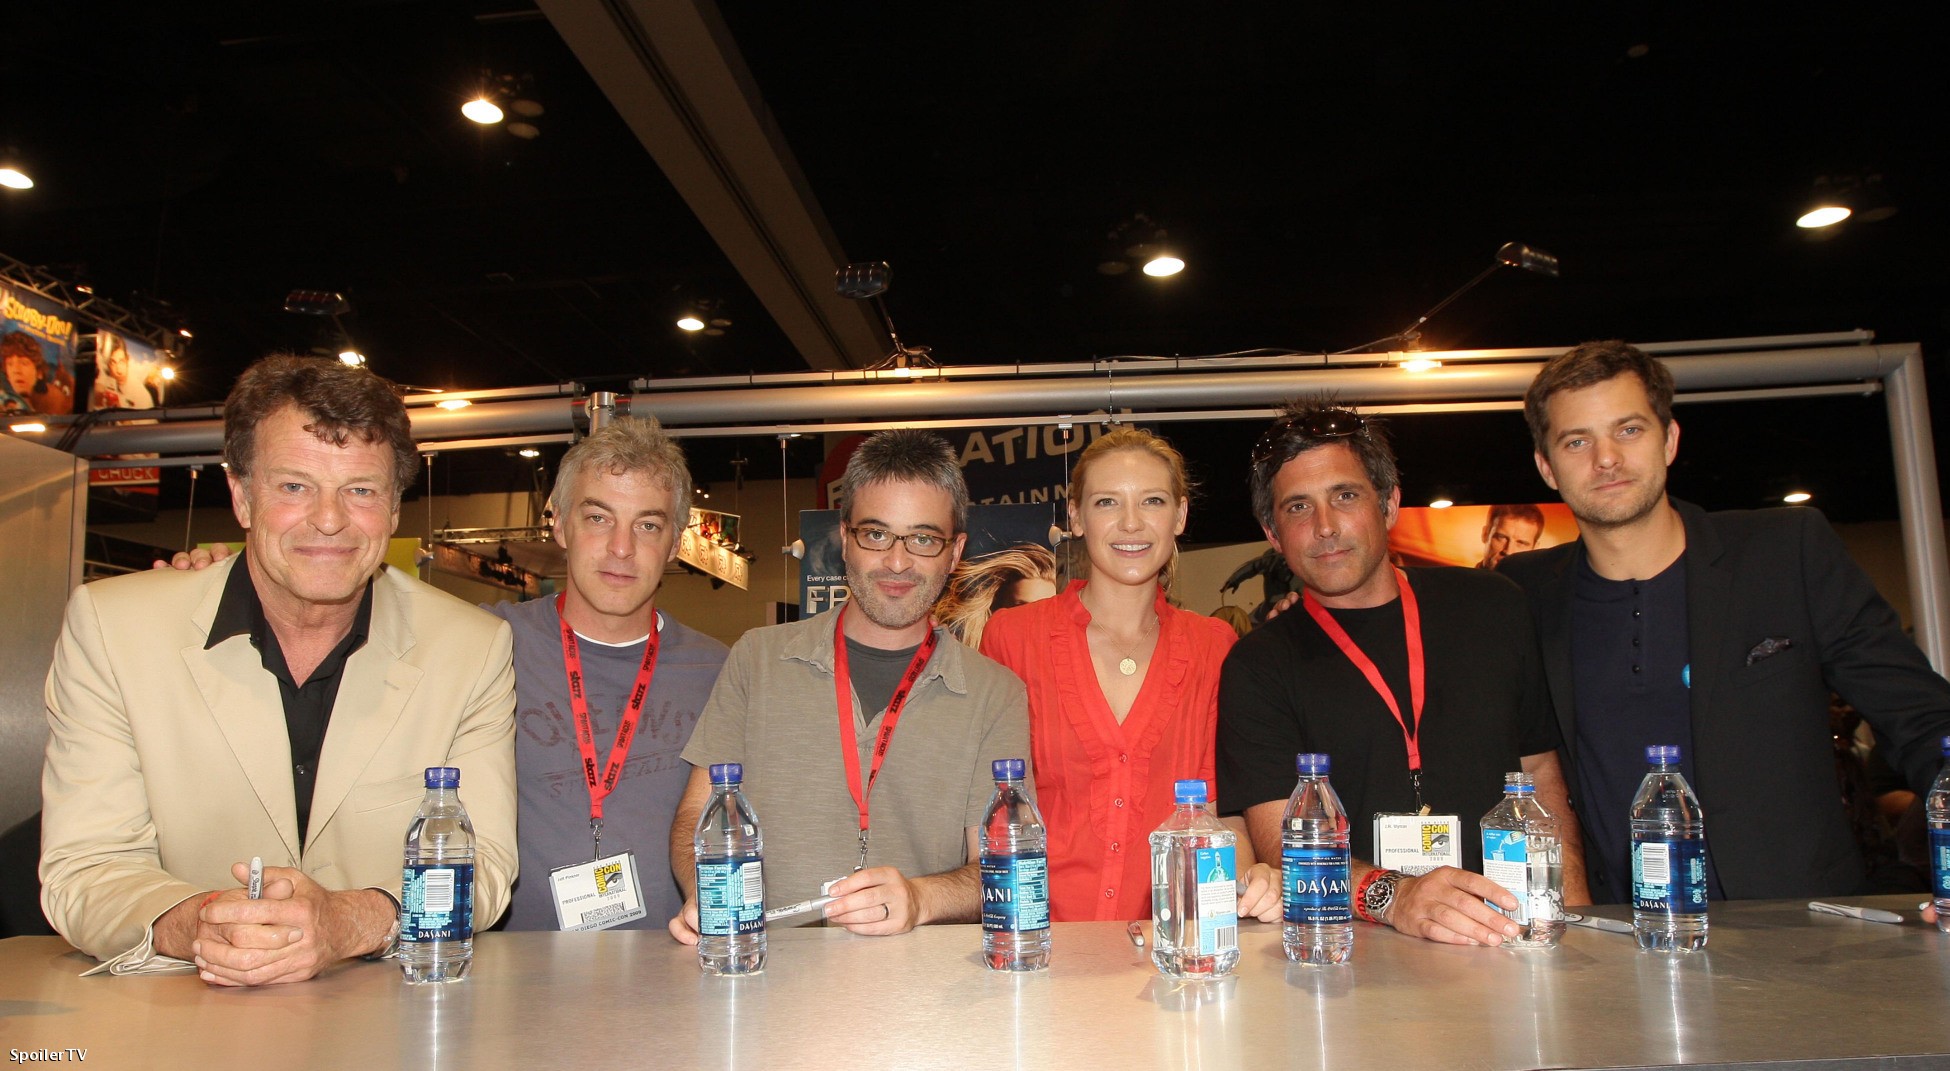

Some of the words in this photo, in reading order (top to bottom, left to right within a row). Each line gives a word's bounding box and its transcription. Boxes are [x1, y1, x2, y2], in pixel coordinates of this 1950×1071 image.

[97, 467, 154, 480] CHUCK
[569, 670, 582, 699] starz
[632, 682, 646, 711] starz
[584, 757, 597, 788] starz
[604, 761, 620, 791] starz
[1431, 824, 1449, 834] CON
[1421, 825, 1432, 852] COMIC
[603, 862, 623, 875] CON
[594, 867, 609, 895] COMIC
[562, 892, 596, 905] PROFESSIONAL
[1640, 899, 1669, 909] DASANI
[580, 923, 598, 932] DIEGO
[598, 913, 629, 926] COMIC-CON
[740, 920, 764, 931] DASANI
[418, 929, 451, 939] DASANI
